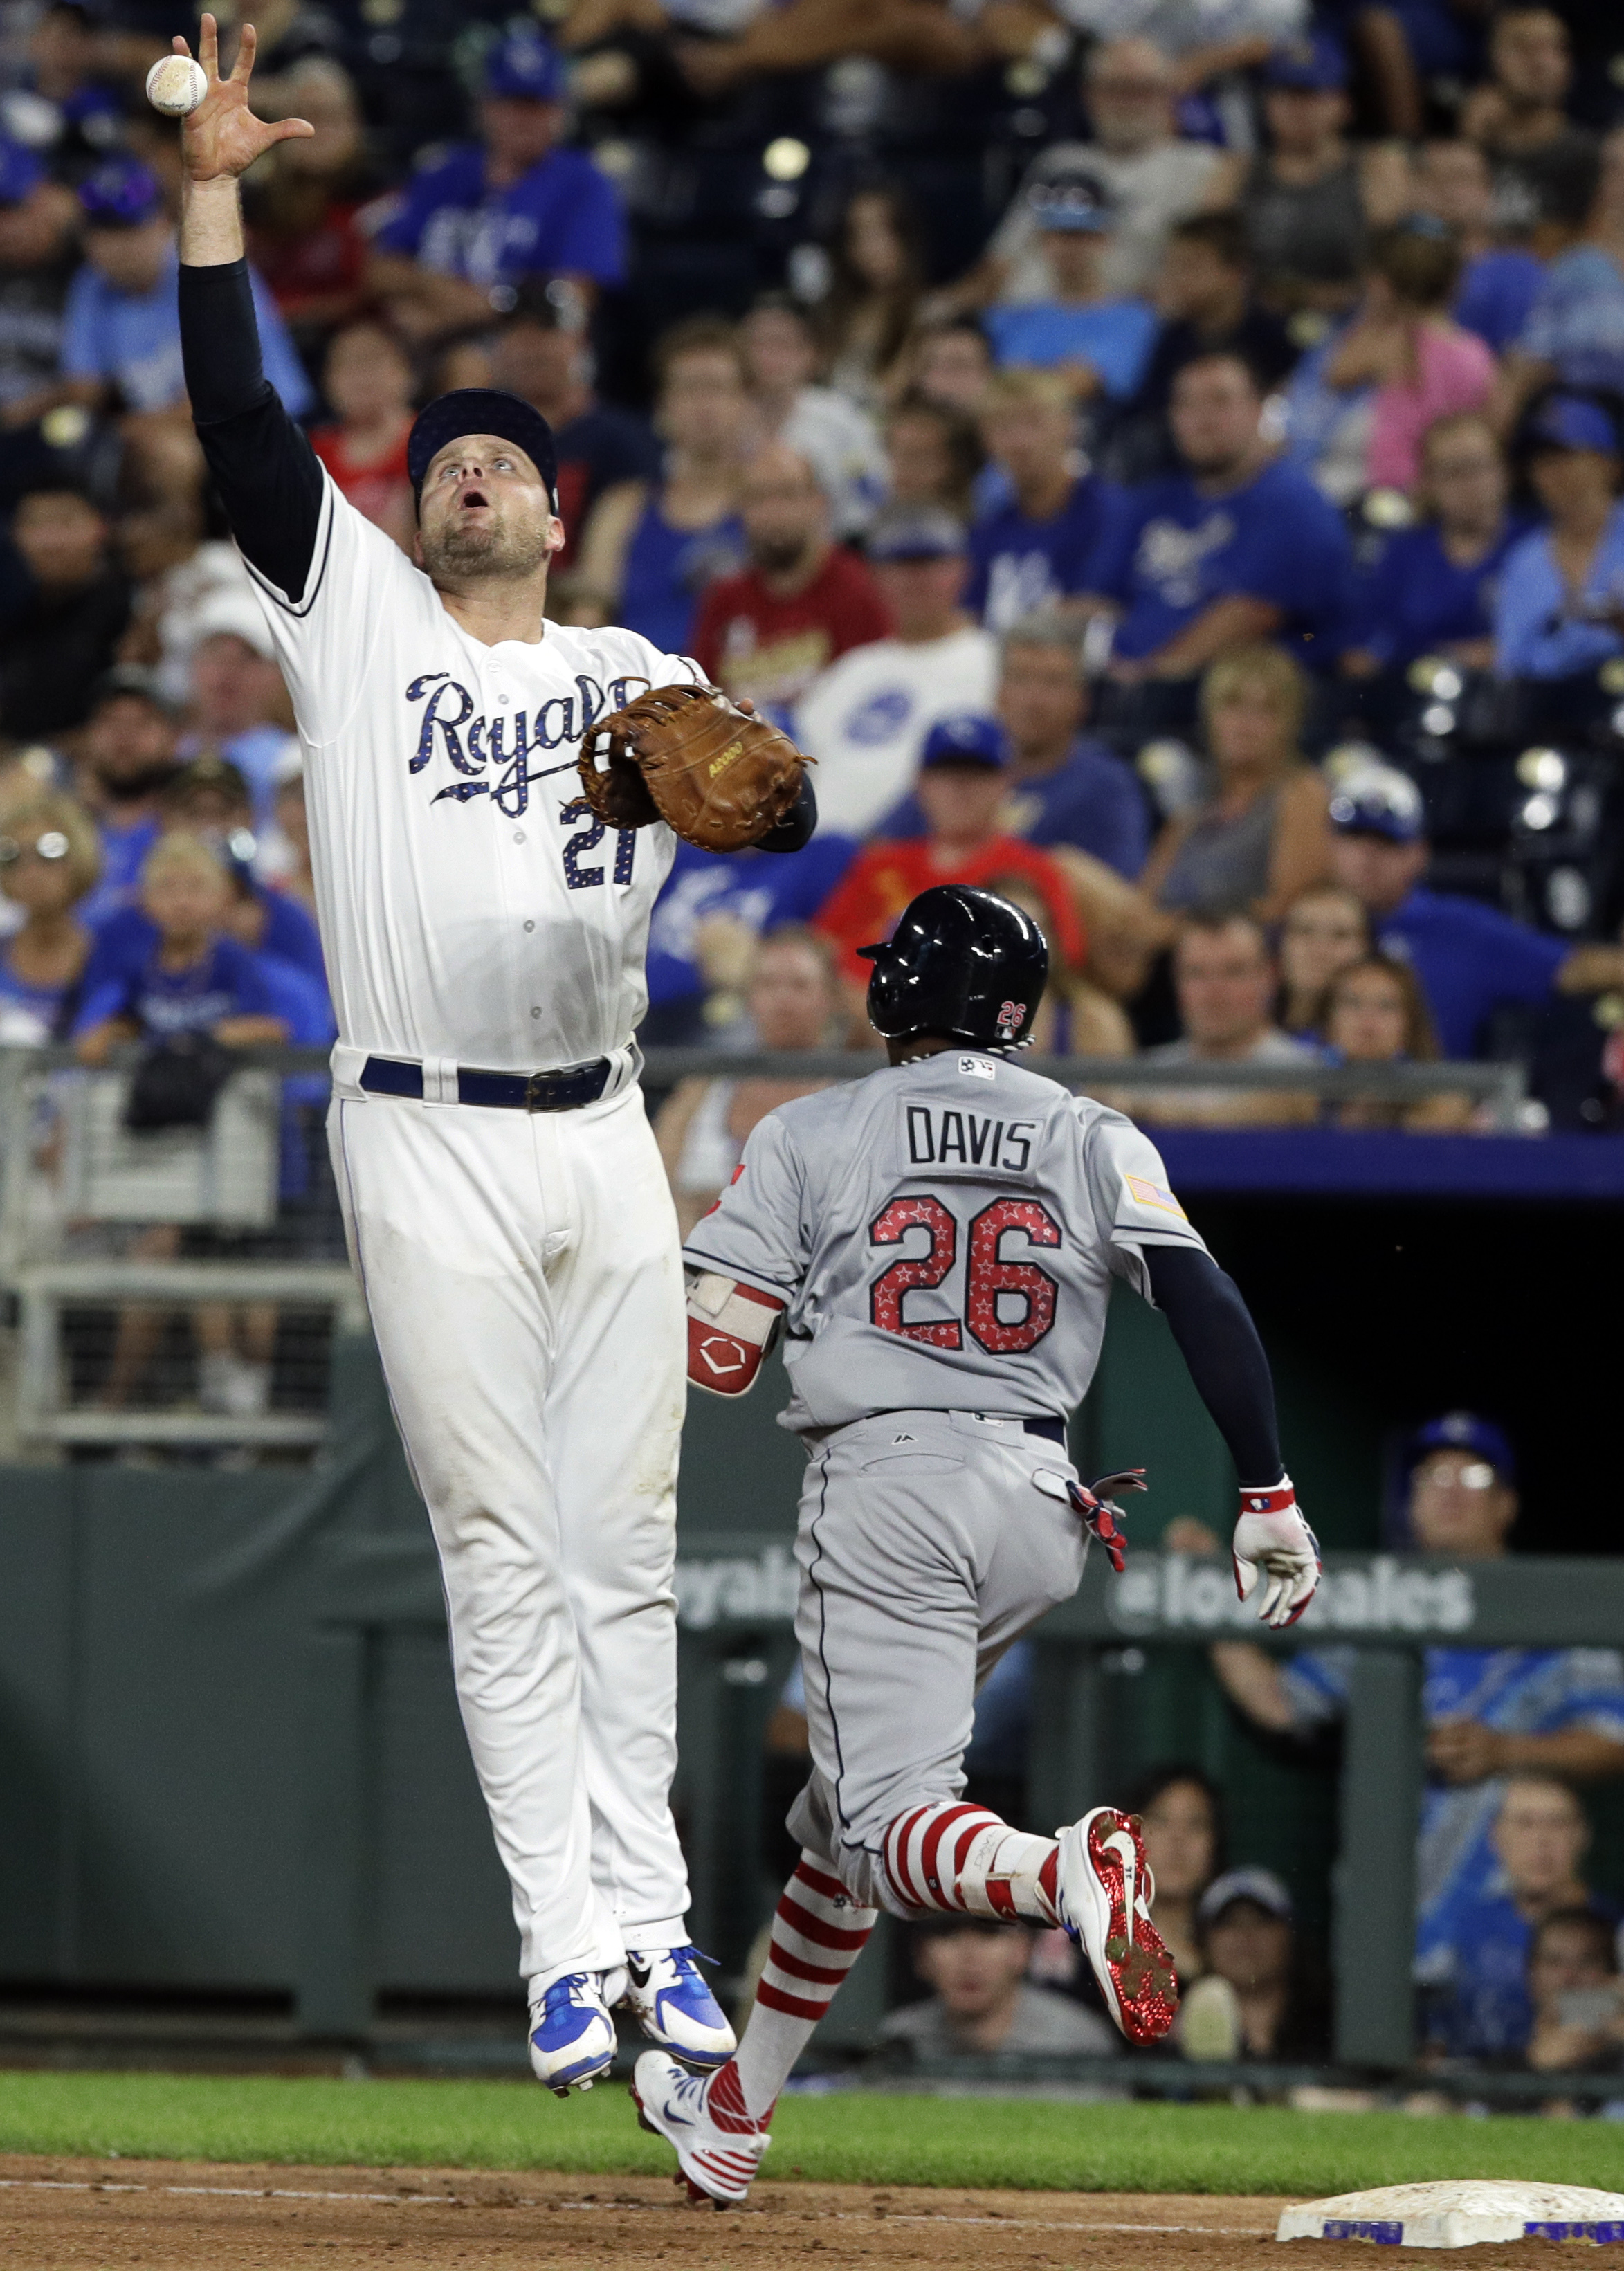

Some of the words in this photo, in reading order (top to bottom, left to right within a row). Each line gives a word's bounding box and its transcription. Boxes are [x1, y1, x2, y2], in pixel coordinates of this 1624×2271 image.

[997, 1001, 1027, 1028] 26
[906, 1106, 1036, 1172] DAVIS
[869, 1194, 1062, 1355] 26
